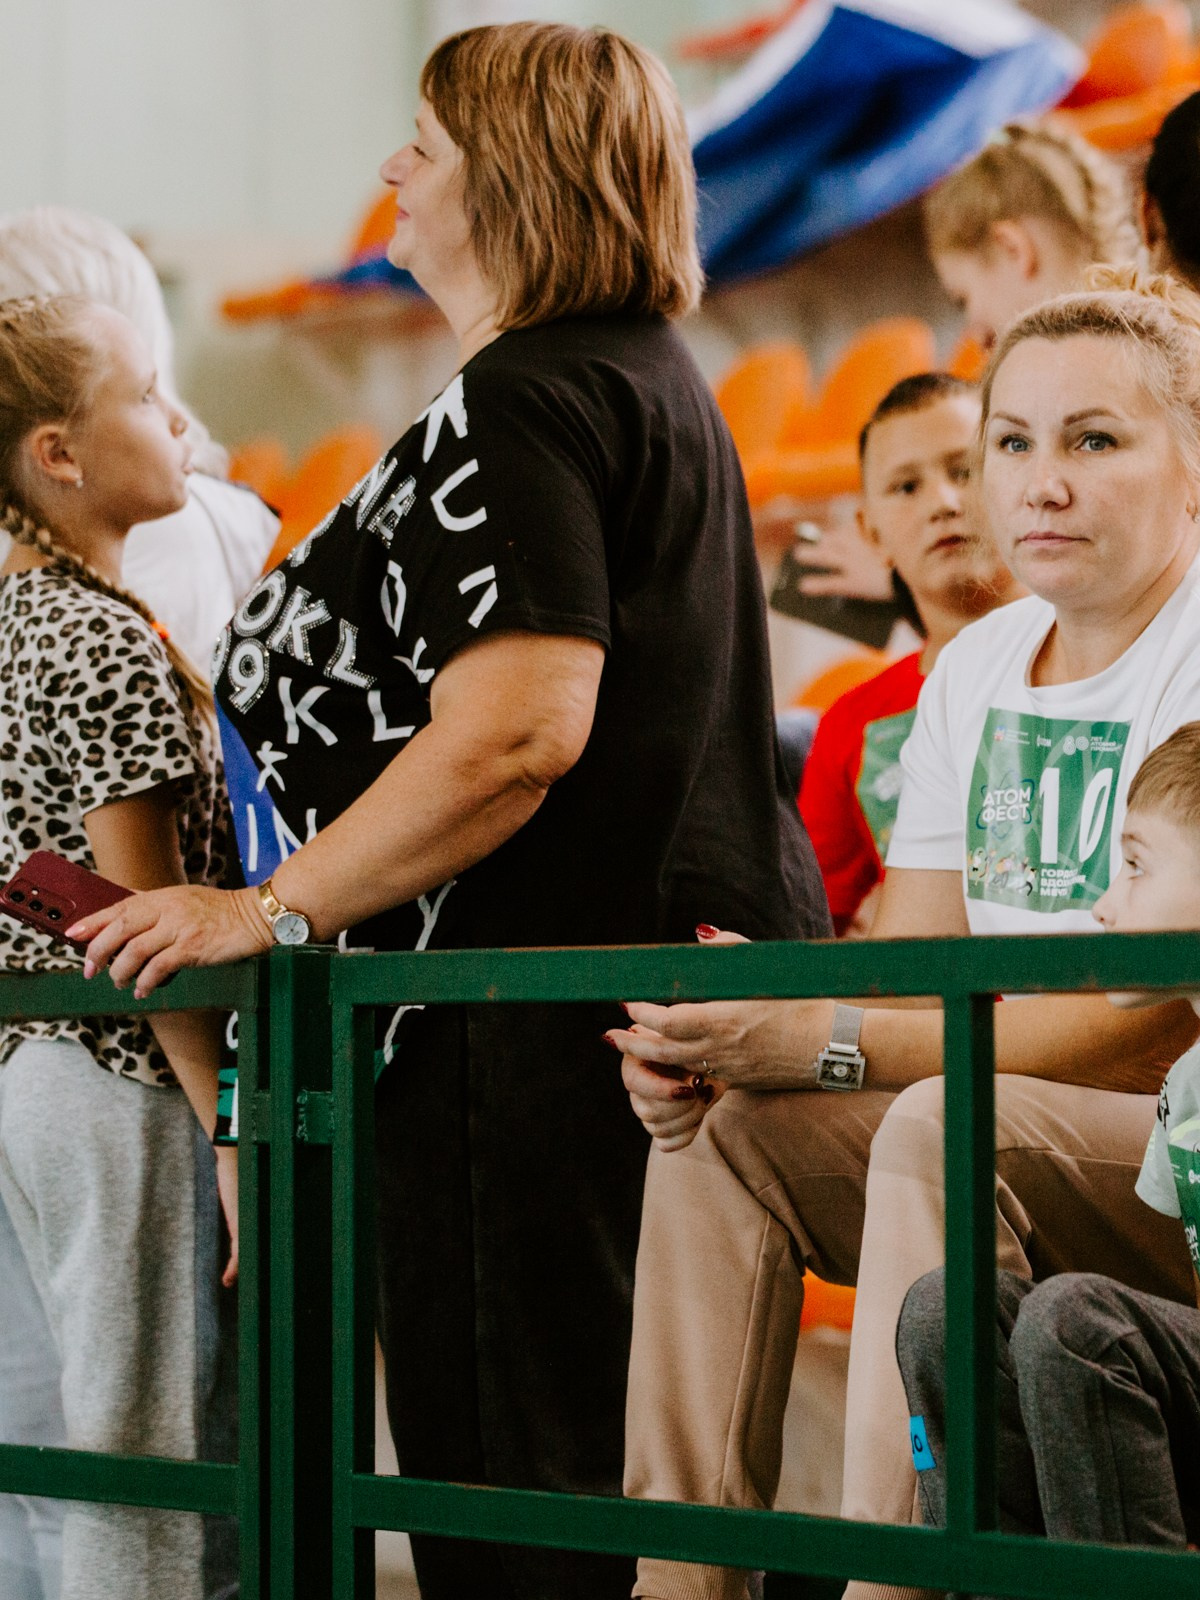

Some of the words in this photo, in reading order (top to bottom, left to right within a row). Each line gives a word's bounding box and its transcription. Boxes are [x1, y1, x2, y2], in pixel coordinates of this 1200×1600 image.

[982, 786, 1031, 808] АТОМ
[982, 803, 1029, 823] ФЕСТ
[1039, 767, 1113, 864] 10
